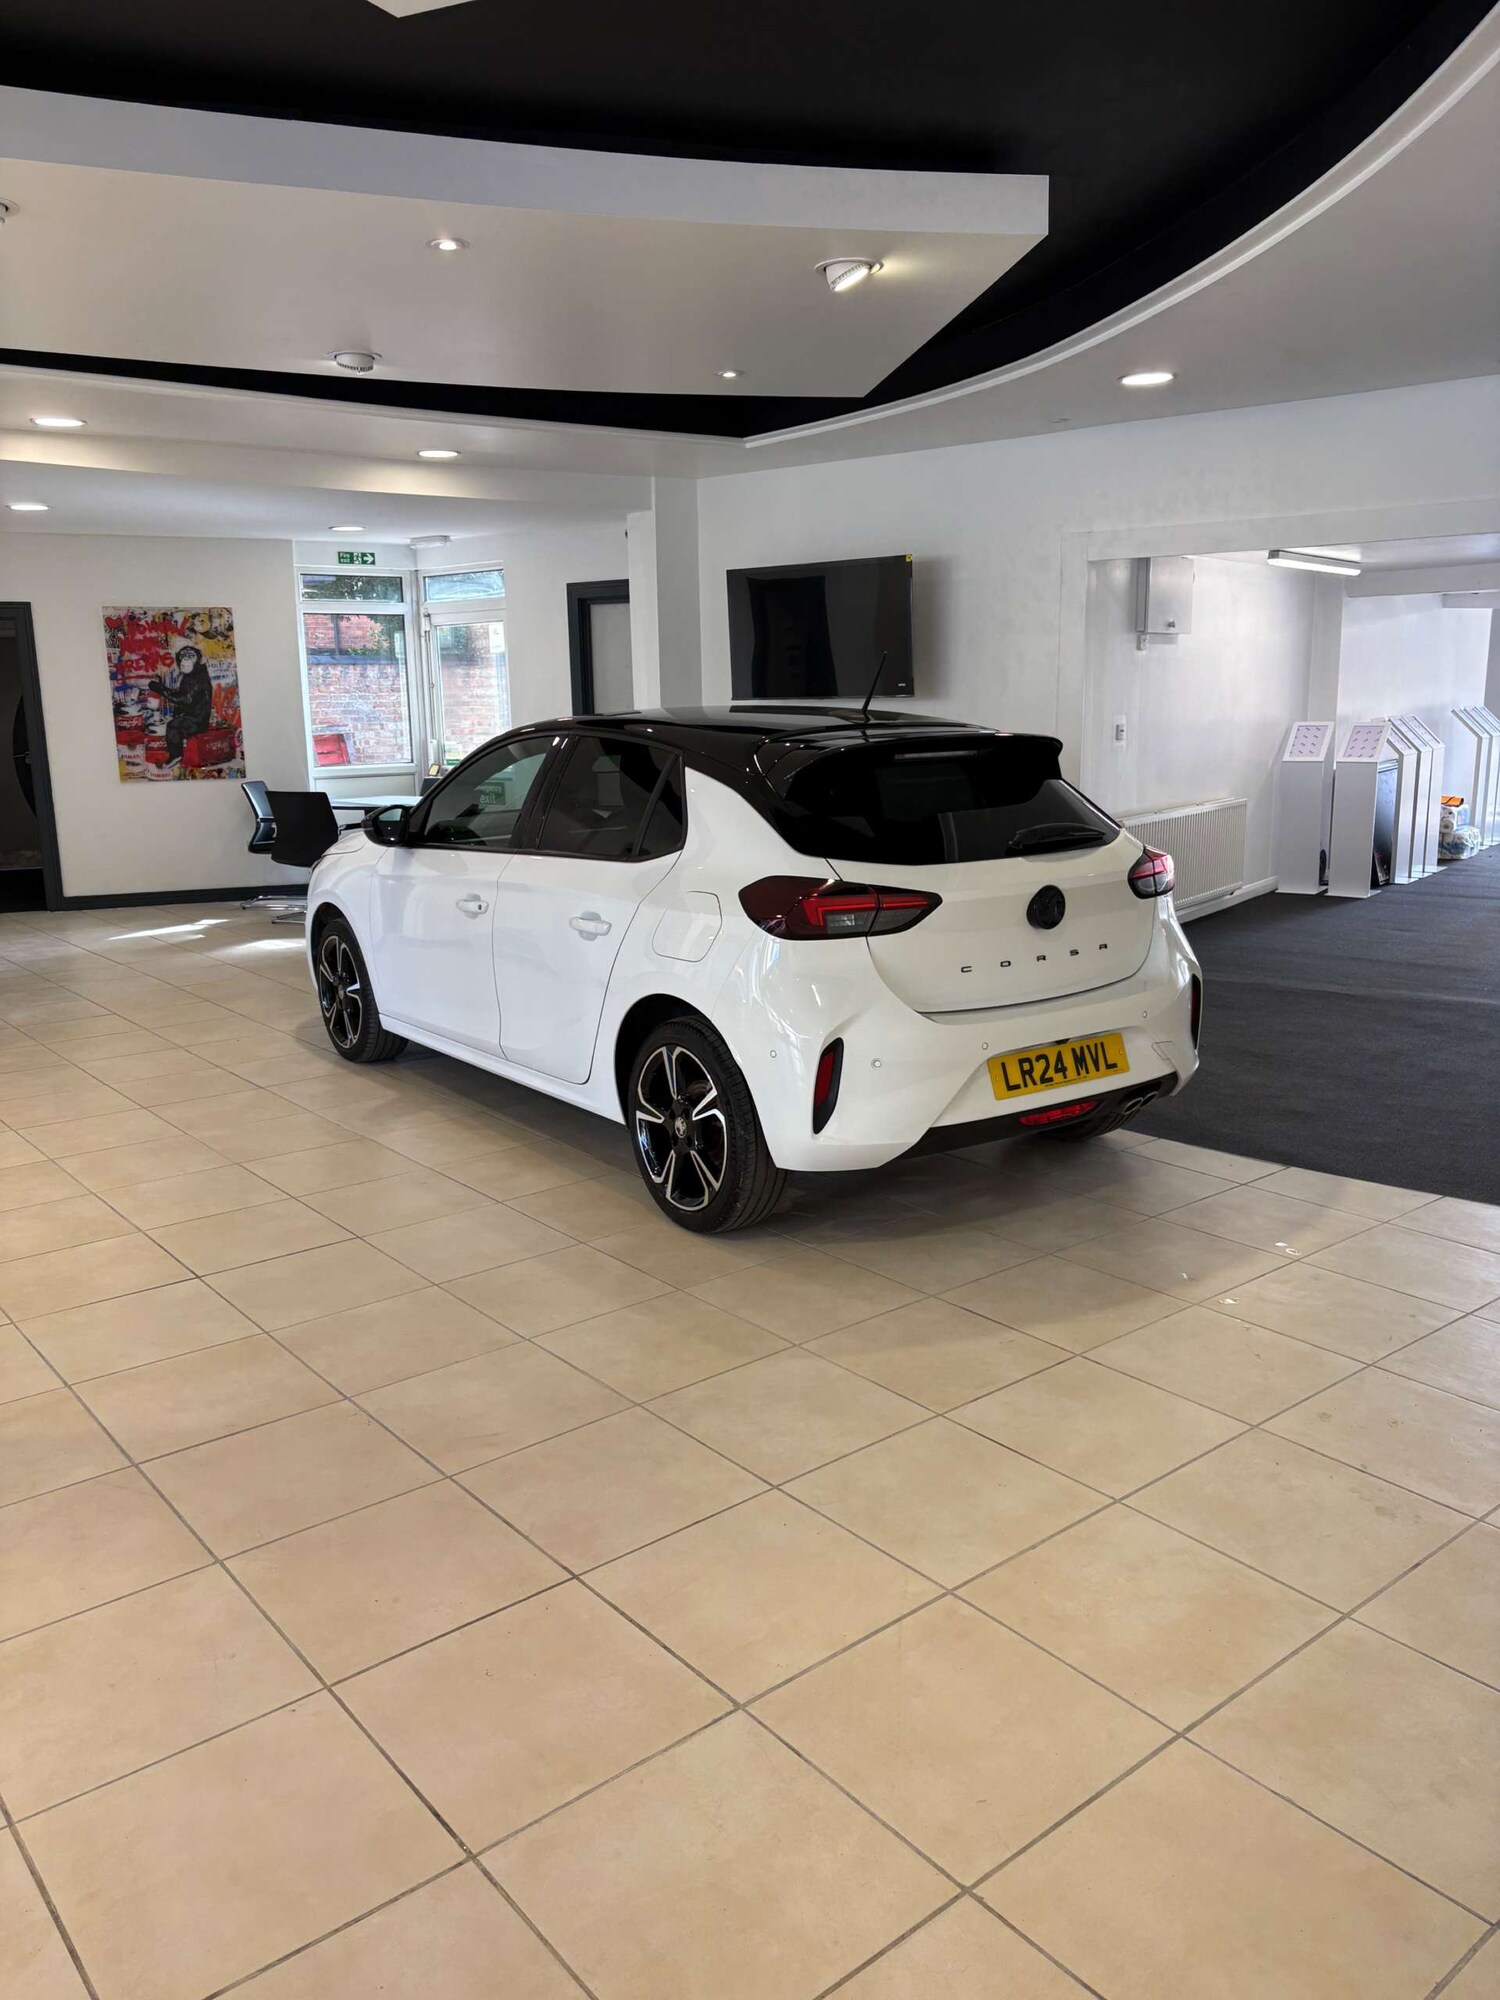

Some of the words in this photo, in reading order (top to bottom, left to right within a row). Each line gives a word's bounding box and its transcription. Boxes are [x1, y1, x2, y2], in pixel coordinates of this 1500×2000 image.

[479, 793, 496, 804] exit
[961, 943, 1108, 973] CORSA
[1001, 1050, 1067, 1092] LR24
[1071, 1042, 1118, 1076] MVL
